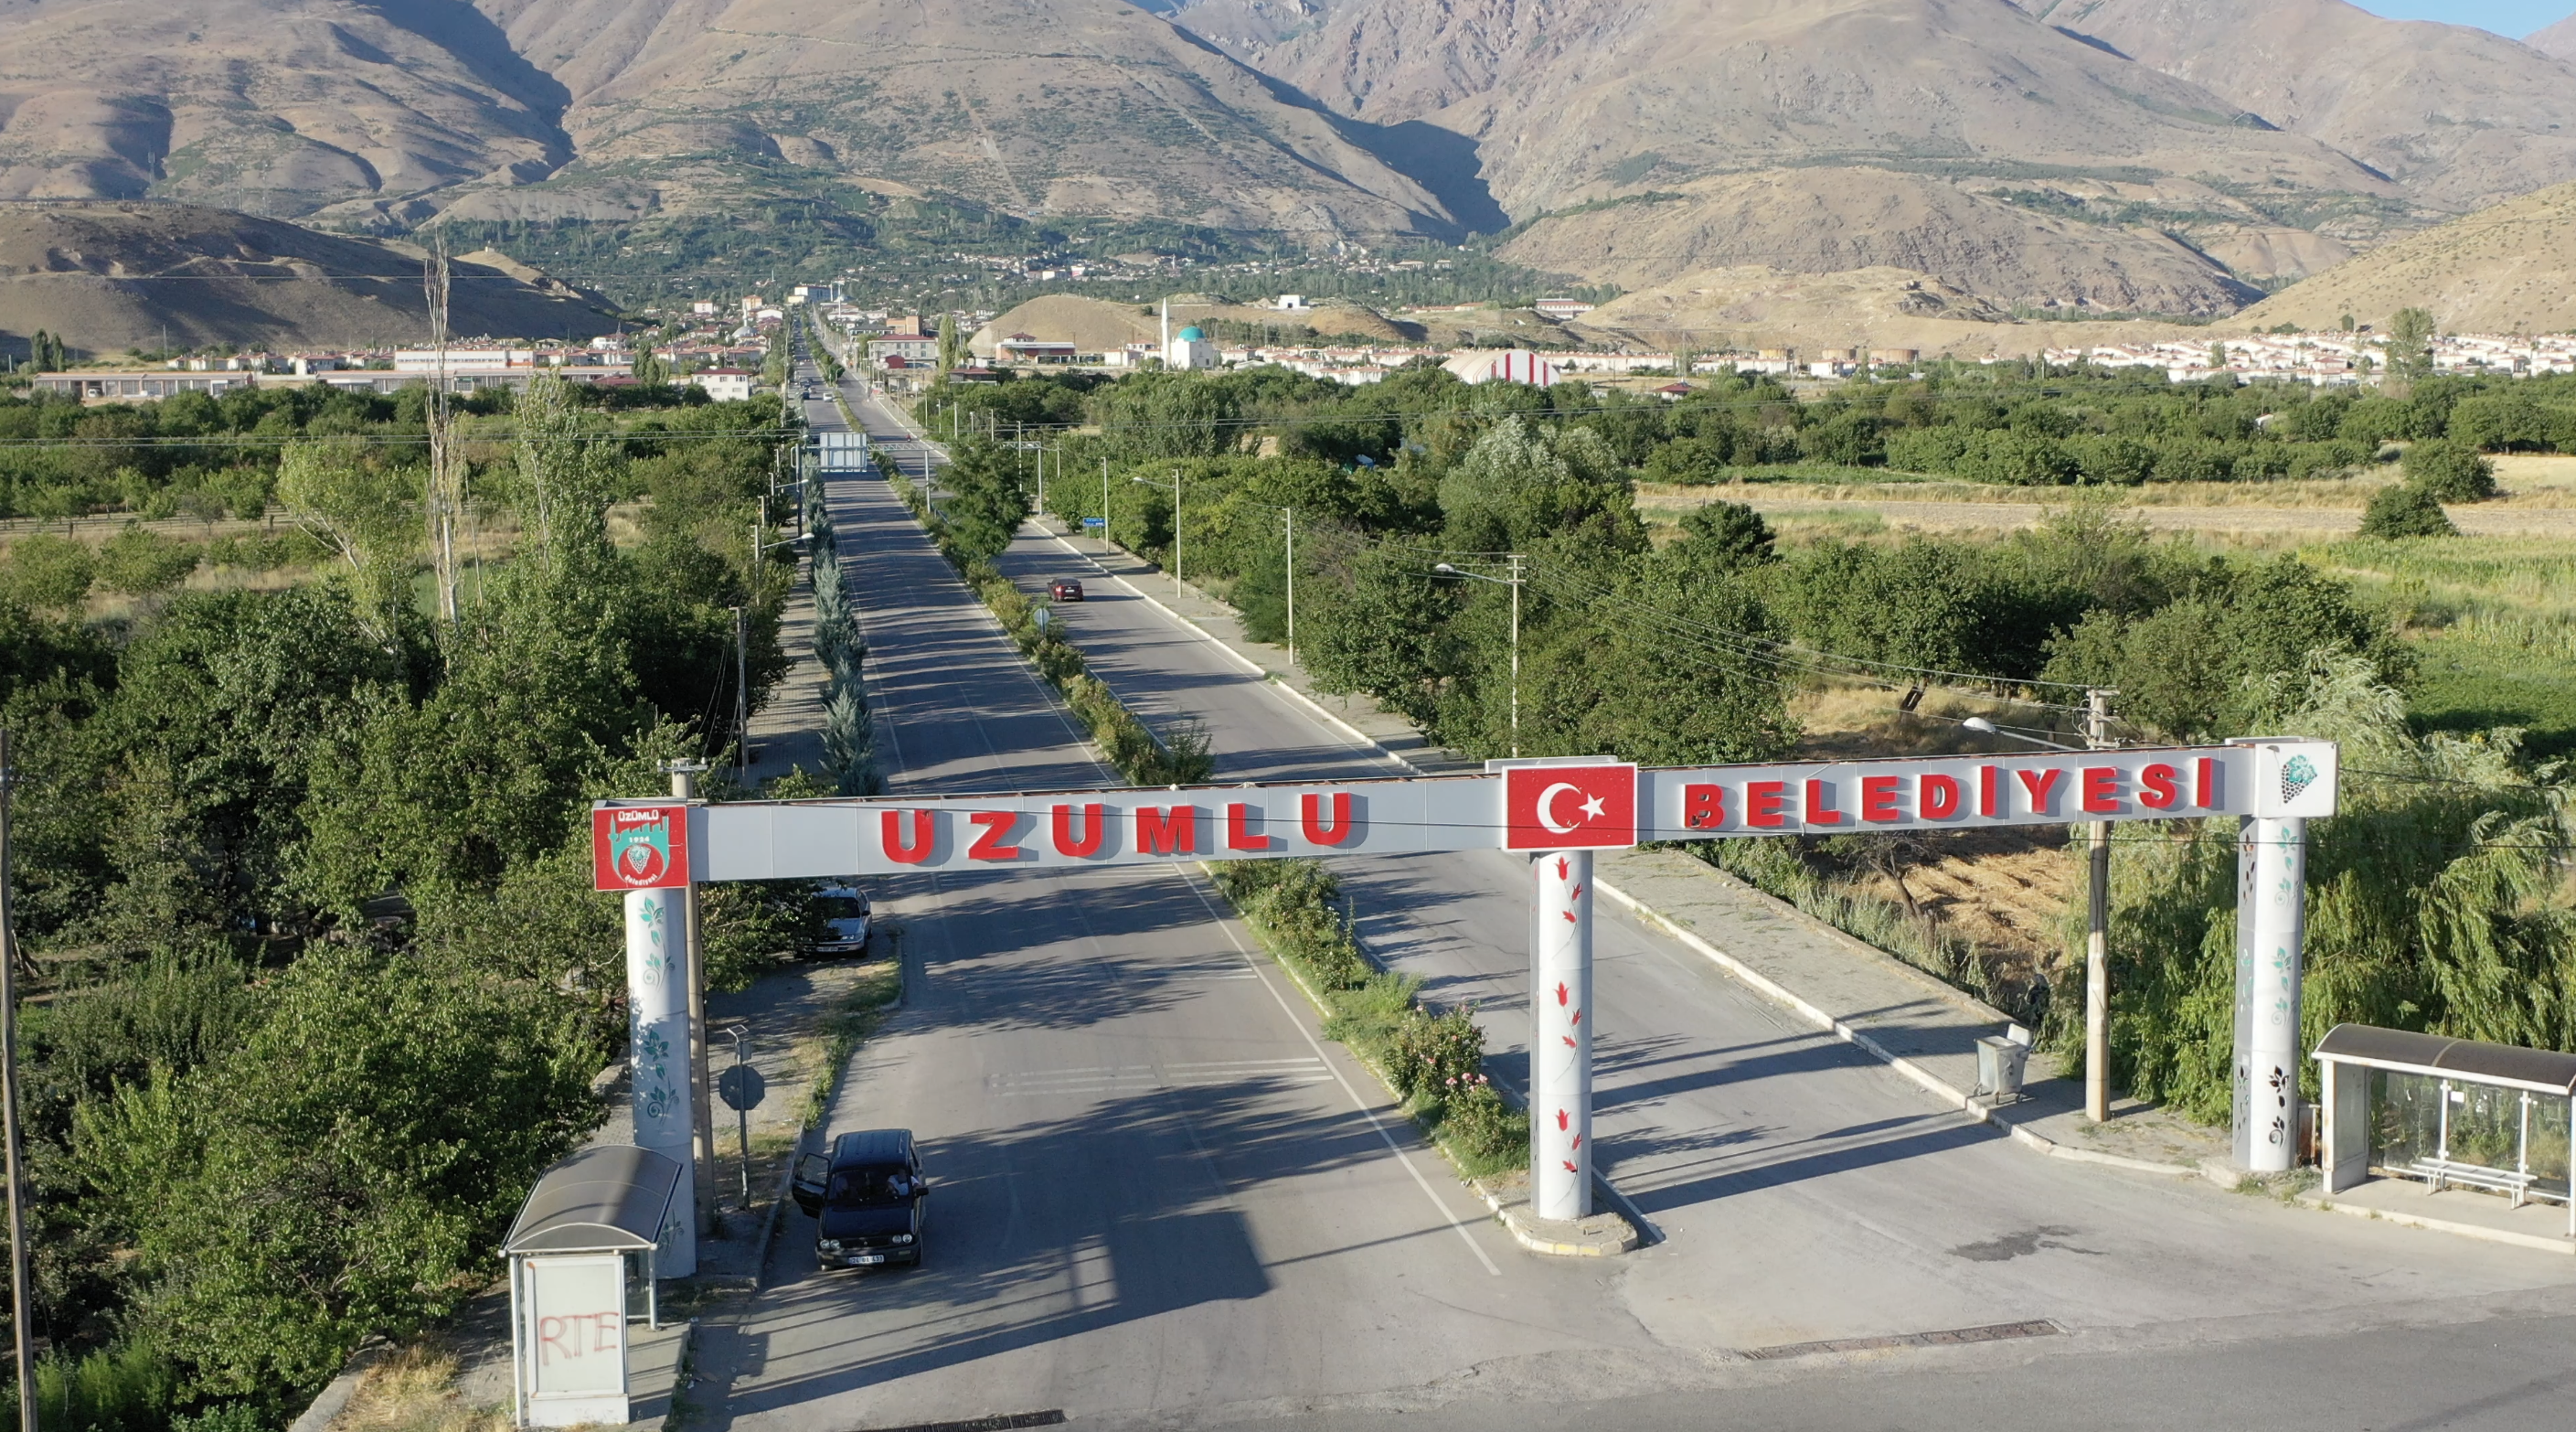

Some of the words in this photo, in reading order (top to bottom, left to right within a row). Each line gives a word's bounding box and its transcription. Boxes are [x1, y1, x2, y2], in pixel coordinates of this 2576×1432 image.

[618, 809, 659, 822] ÜZÜMLÜ
[881, 793, 1351, 864] UZUMLU
[1685, 757, 2213, 829] BELEDIYESI
[624, 873, 658, 886] Belediyesi
[540, 1312, 619, 1366] RTE
